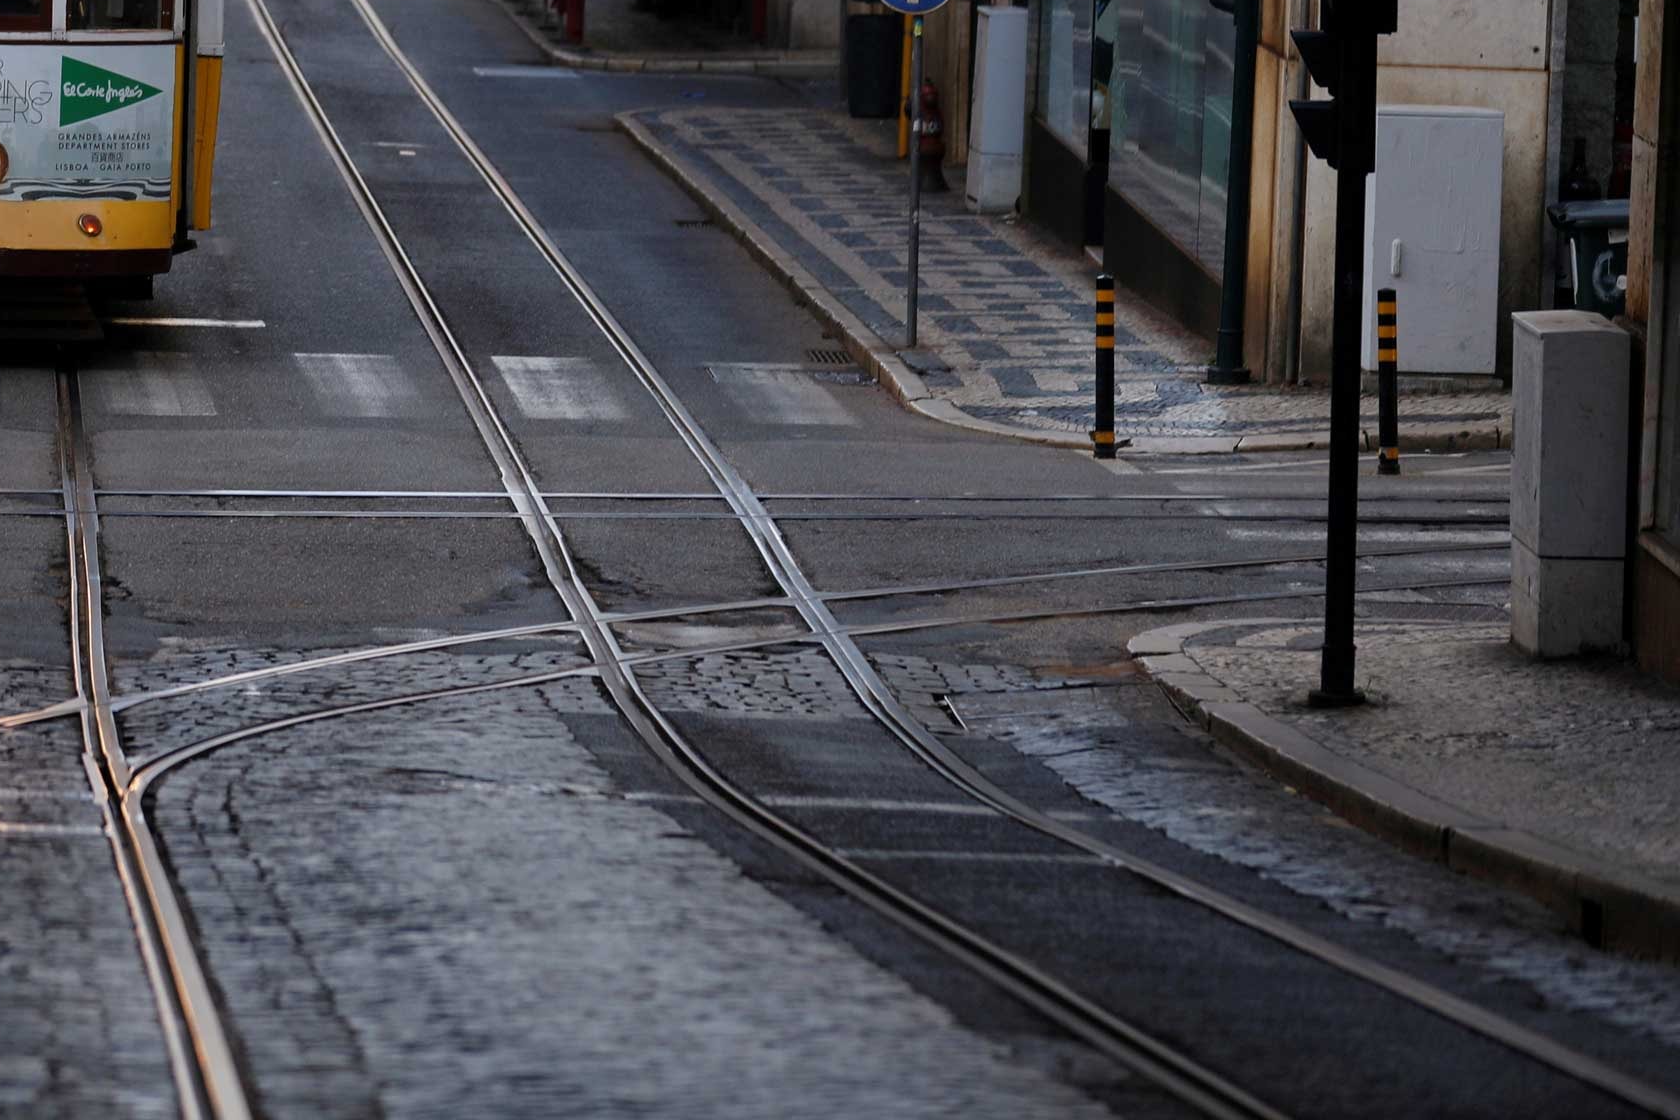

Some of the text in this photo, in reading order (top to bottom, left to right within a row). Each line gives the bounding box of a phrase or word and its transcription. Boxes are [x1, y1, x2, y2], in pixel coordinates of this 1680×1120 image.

[63, 81, 77, 97] El
[77, 82, 105, 98] Corte
[57, 133, 102, 141] GRANDES
[58, 142, 150, 150] DEPARTMENT STORES
[55, 163, 151, 171] LISBOA GAIA PORTO
